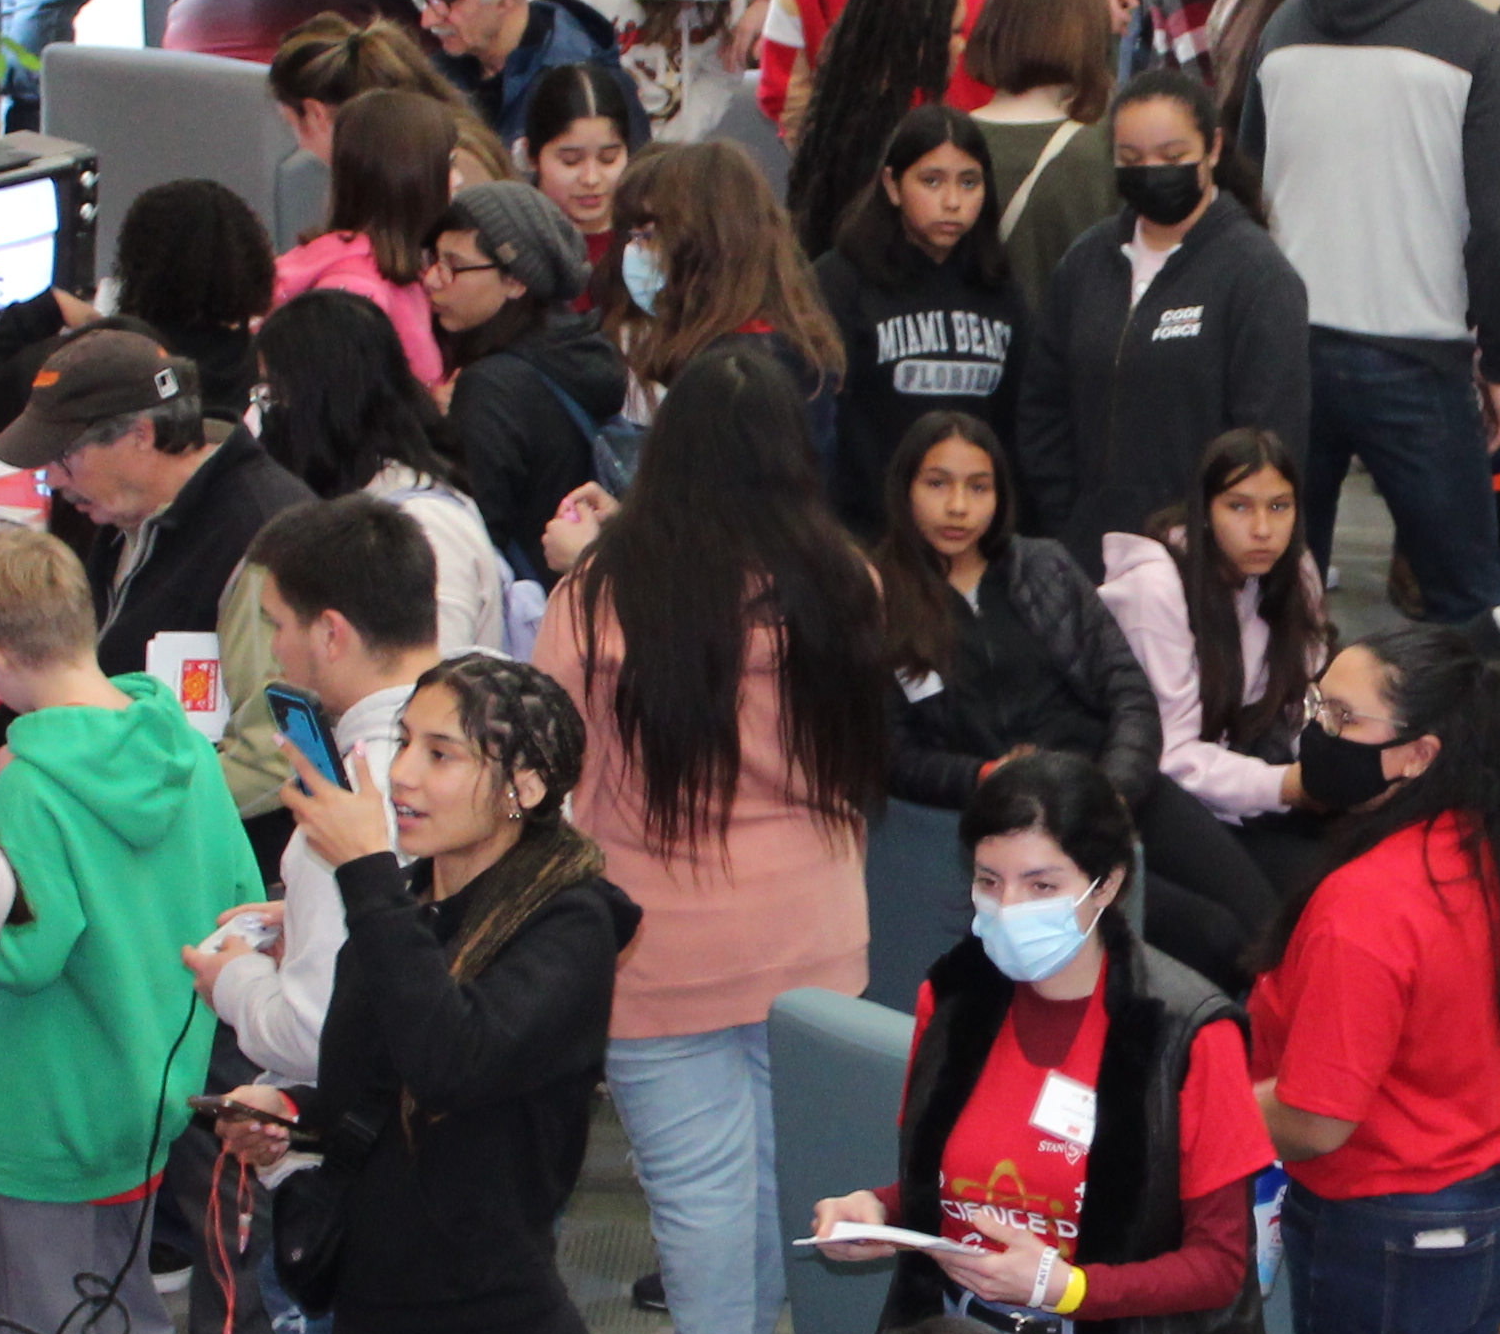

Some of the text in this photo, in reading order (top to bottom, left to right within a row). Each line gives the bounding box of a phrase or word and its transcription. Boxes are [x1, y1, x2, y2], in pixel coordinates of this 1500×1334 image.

[1159, 304, 1205, 323] CODE
[876, 309, 1013, 365] MIAMI BEAC
[1151, 322, 1204, 342] FORCE
[940, 1199, 1048, 1235] CIENCE
